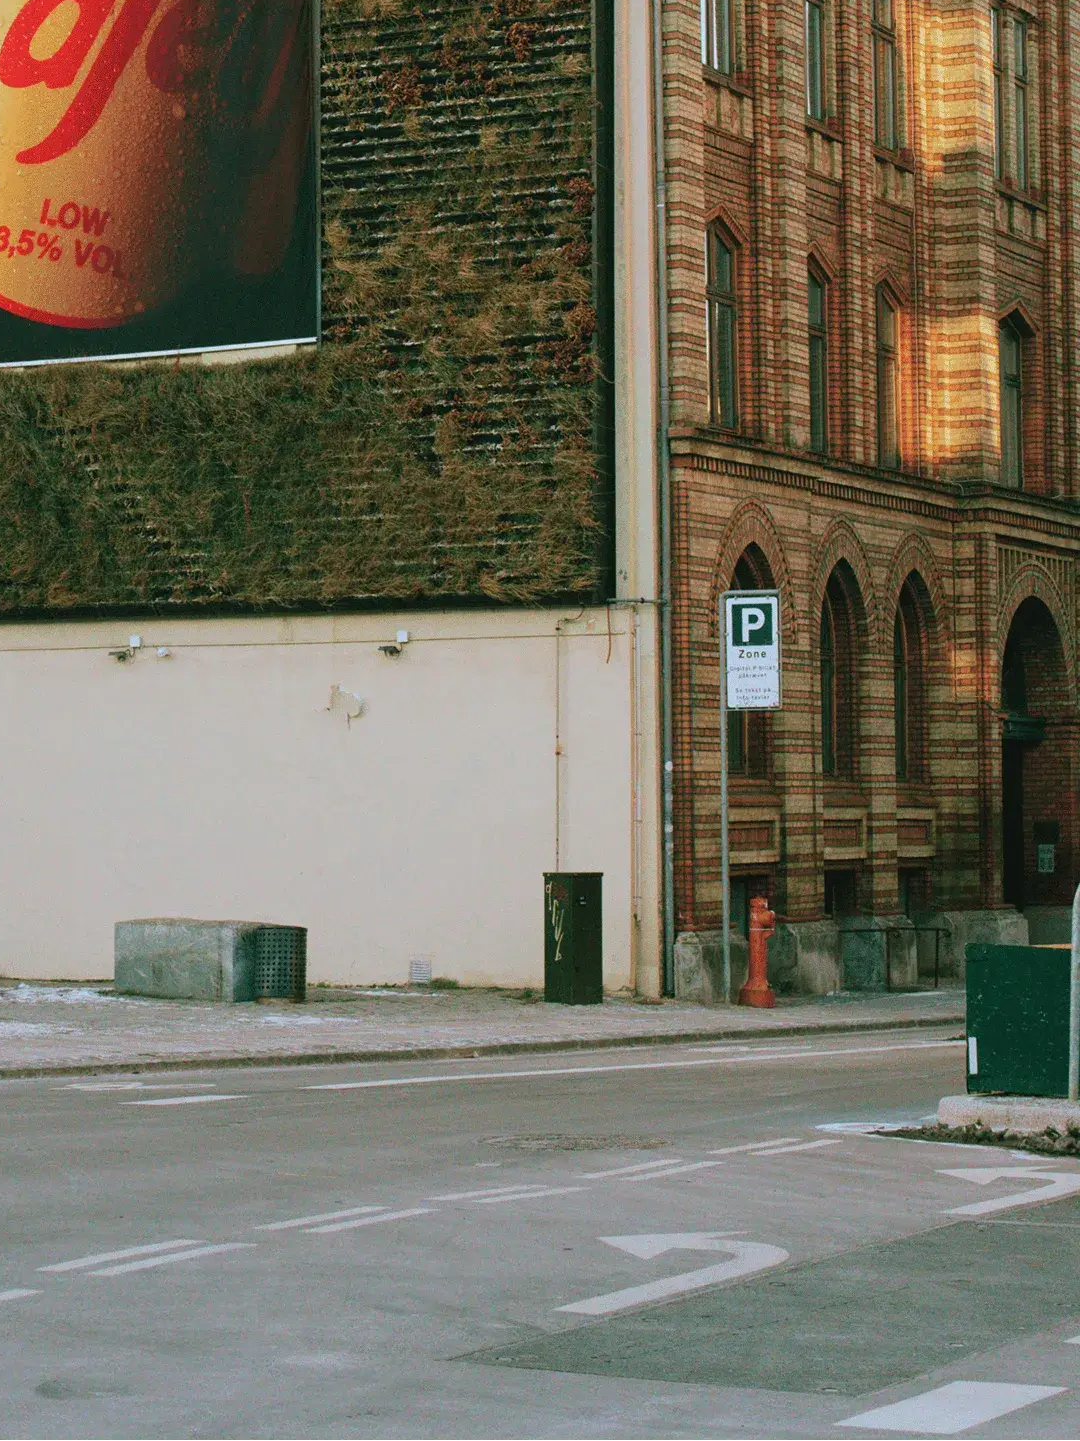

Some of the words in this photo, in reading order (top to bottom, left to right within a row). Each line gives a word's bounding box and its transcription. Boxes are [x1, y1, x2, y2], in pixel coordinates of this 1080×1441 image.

[40, 197, 111, 236] LOW
[741, 607, 765, 643] P
[738, 649, 767, 659] Zone
